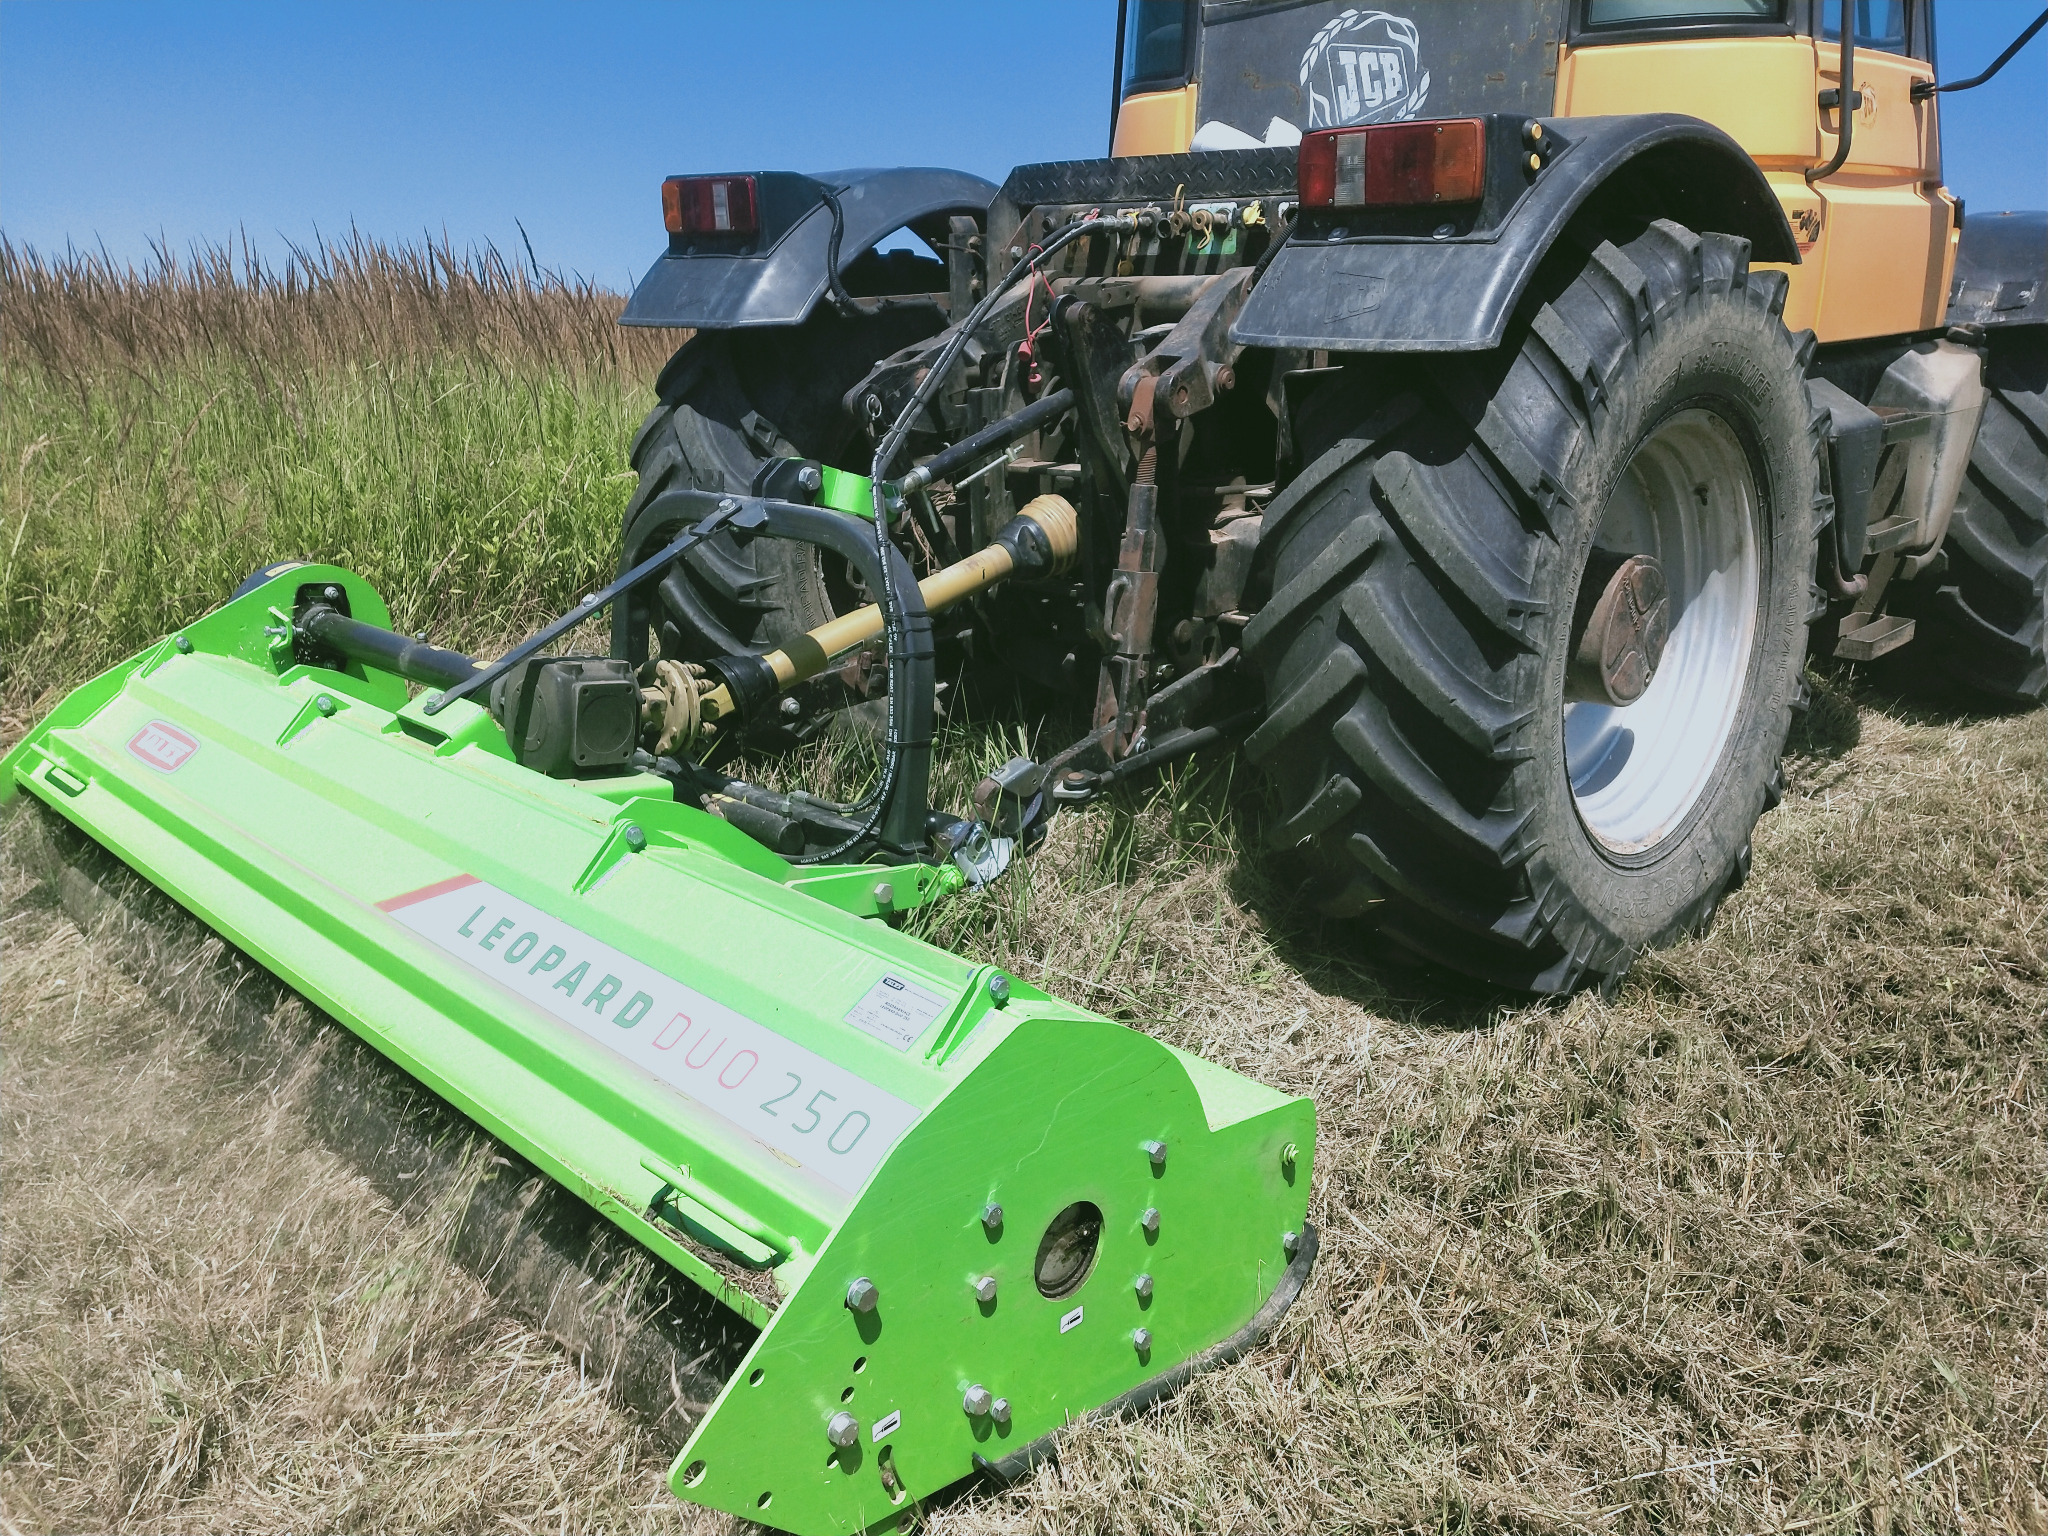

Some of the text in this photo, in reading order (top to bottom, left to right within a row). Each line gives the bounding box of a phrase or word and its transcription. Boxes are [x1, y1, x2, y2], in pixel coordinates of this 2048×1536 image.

[1337, 50, 1403, 121] JCB
[457, 905, 871, 1155] LEOPARD DUO 250
